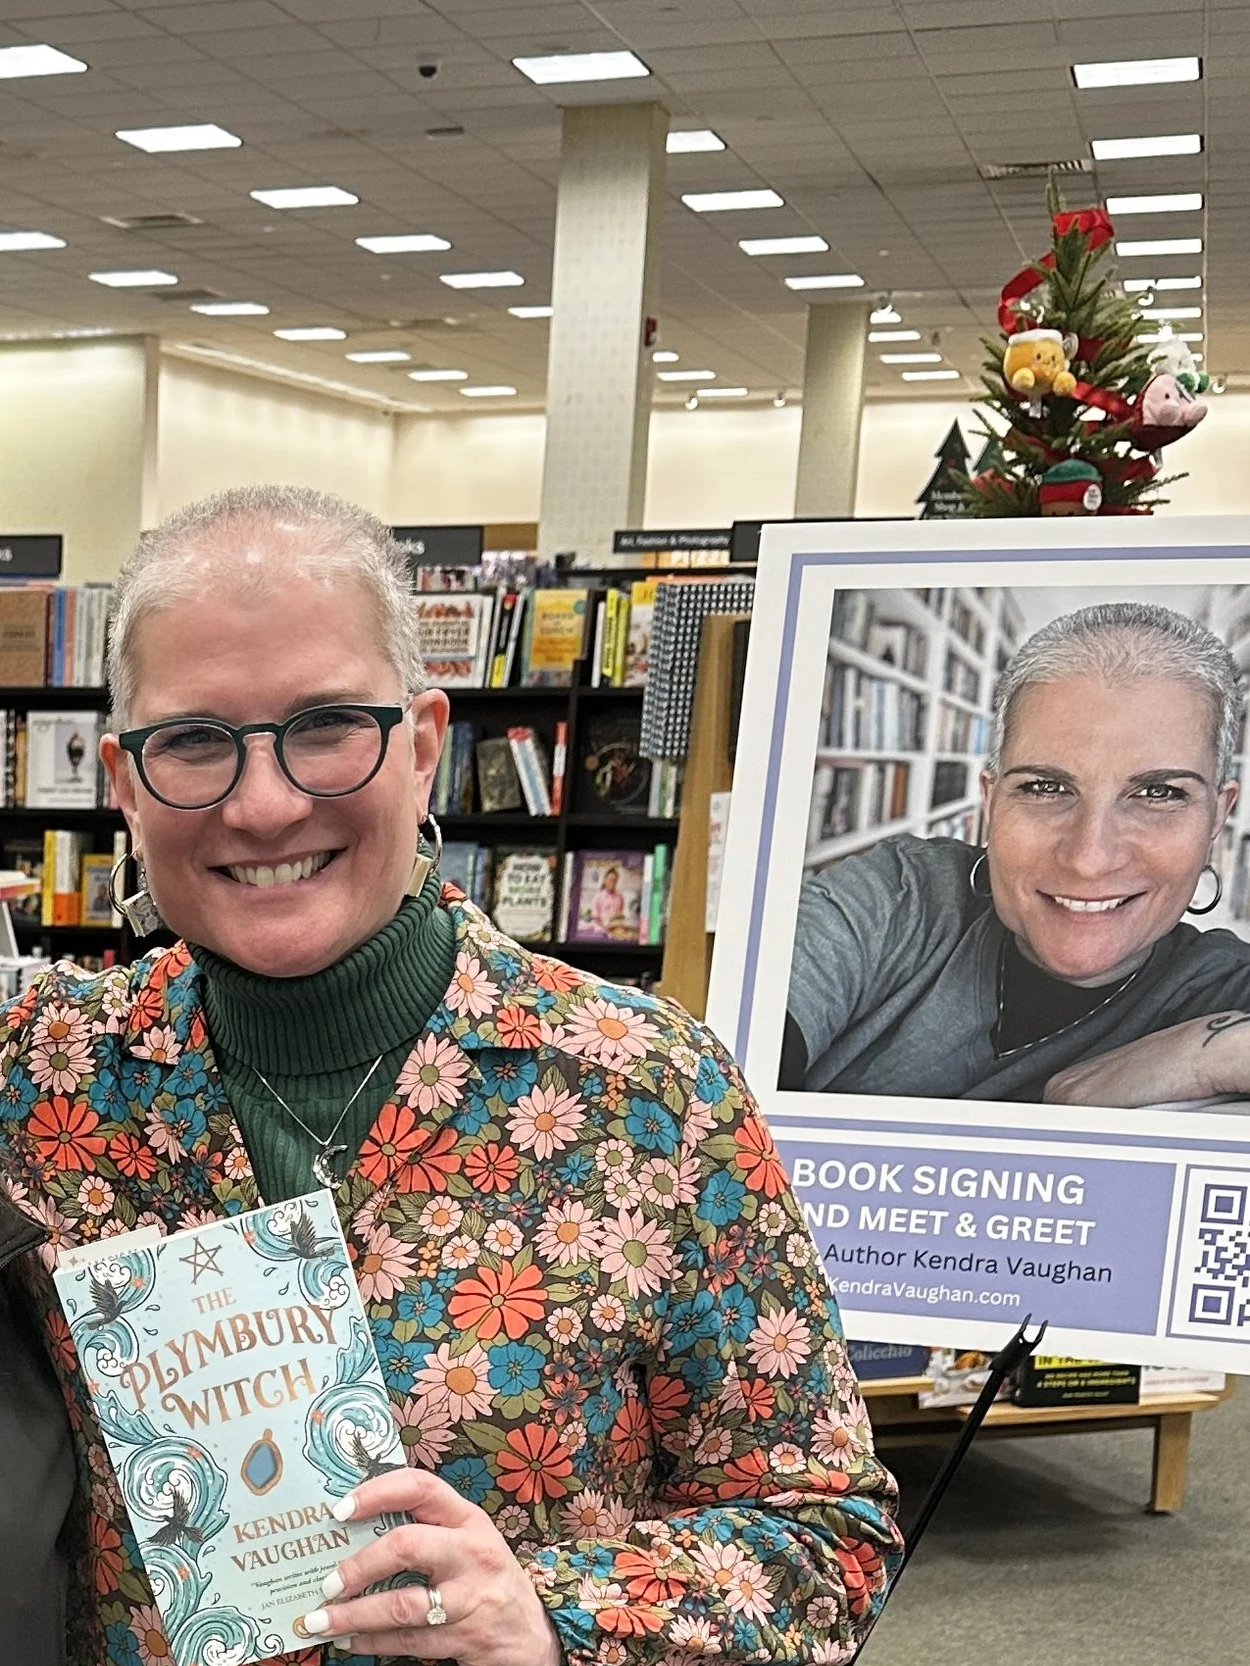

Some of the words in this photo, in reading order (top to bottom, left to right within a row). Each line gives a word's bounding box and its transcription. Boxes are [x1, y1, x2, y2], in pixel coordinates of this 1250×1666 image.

[791, 1158, 904, 1195] BOOK
[912, 1165, 1086, 1206] SIGNING
[802, 1201, 850, 1230] ND
[858, 1206, 949, 1238] MEET
[954, 1212, 978, 1239] &
[986, 1213, 1097, 1248] GREET
[823, 1242, 907, 1268] Author
[913, 1249, 999, 1276] Kendra
[1006, 1256, 1114, 1285] Vaughan
[192, 1286, 237, 1315] THE
[119, 1302, 338, 1412] PLYMBURY
[162, 1356, 318, 1431] WITCH
[232, 1501, 334, 1544] KENDRA
[230, 1526, 351, 1572] VAUGHAN
